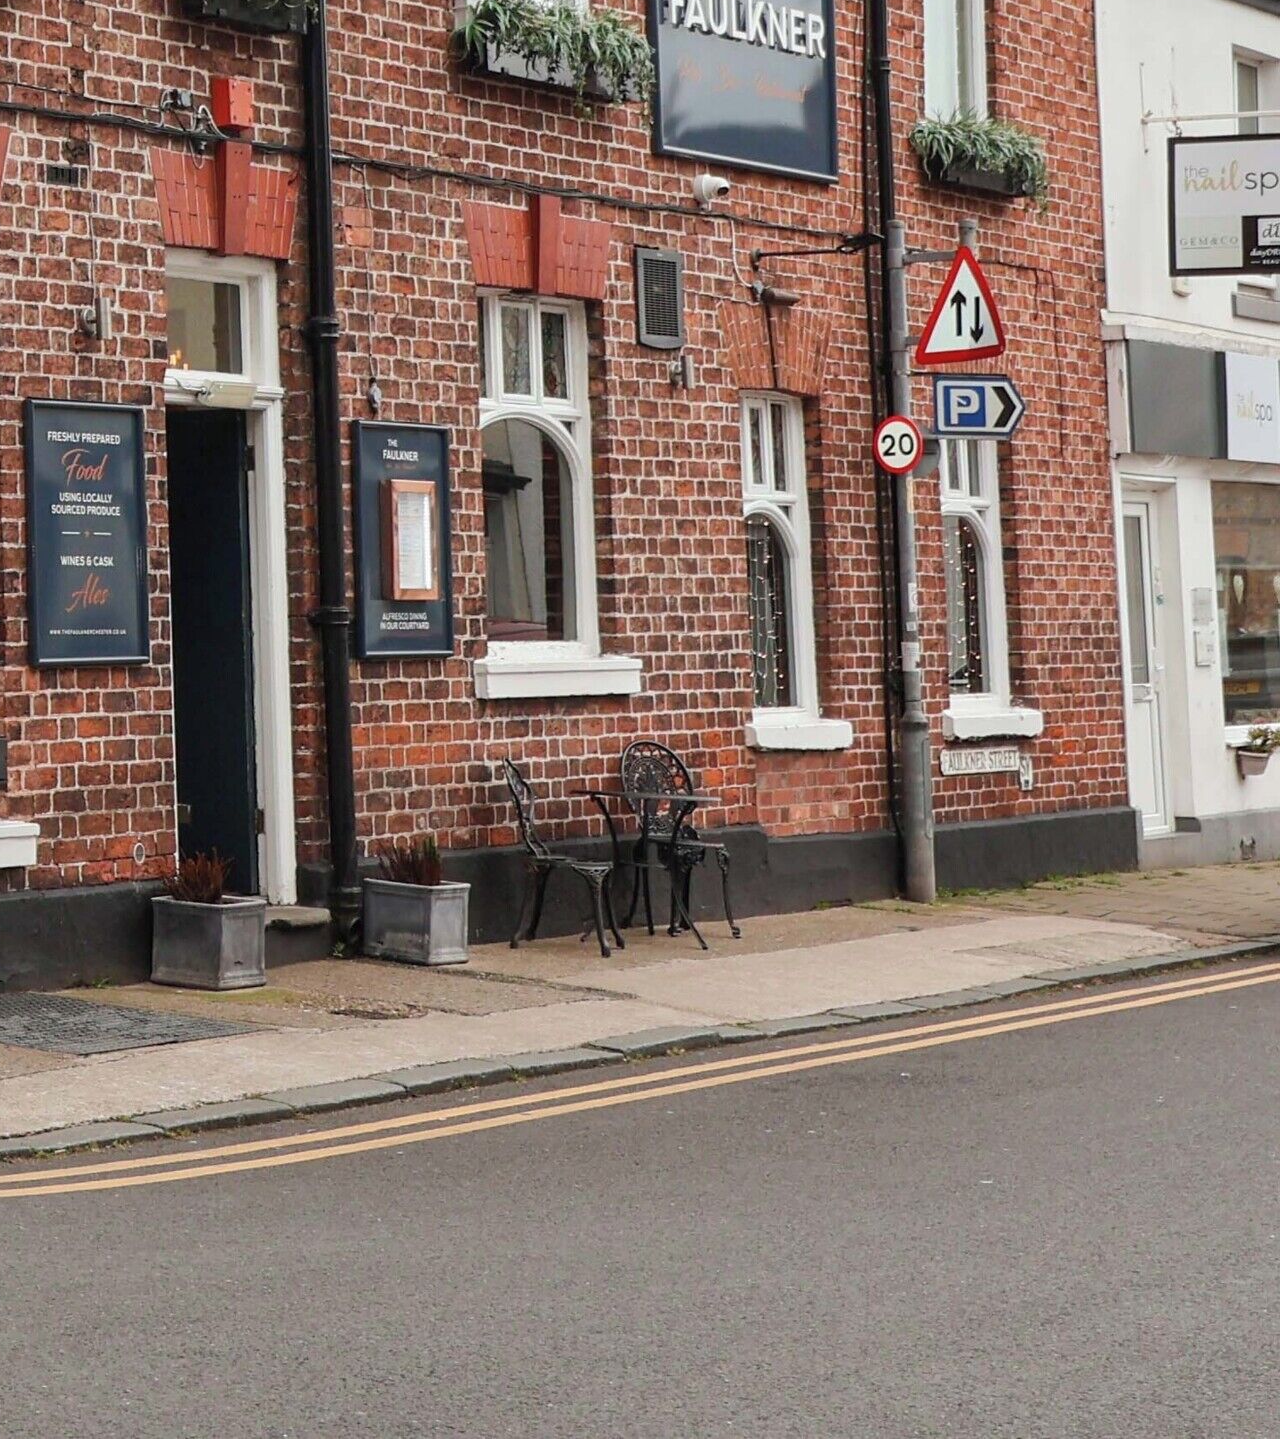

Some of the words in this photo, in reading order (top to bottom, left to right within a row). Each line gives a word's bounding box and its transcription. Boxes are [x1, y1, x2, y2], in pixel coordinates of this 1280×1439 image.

[949, 389, 980, 425] P
[47, 431, 81, 443] FRESHLY
[81, 432, 121, 445] PREPARED
[387, 438, 398, 448] THE
[882, 434, 914, 457] 20
[382, 449, 419, 462] FAULKNER
[61, 448, 109, 487] Food
[59, 492, 82, 503] USING
[82, 492, 113, 504] LOCALLY
[51, 504, 86, 515] SOURCED
[86, 505, 121, 516] PRODUCE
[60, 556, 85, 566] WINES
[93, 556, 114, 567] CASK
[66, 573, 109, 613] Ales
